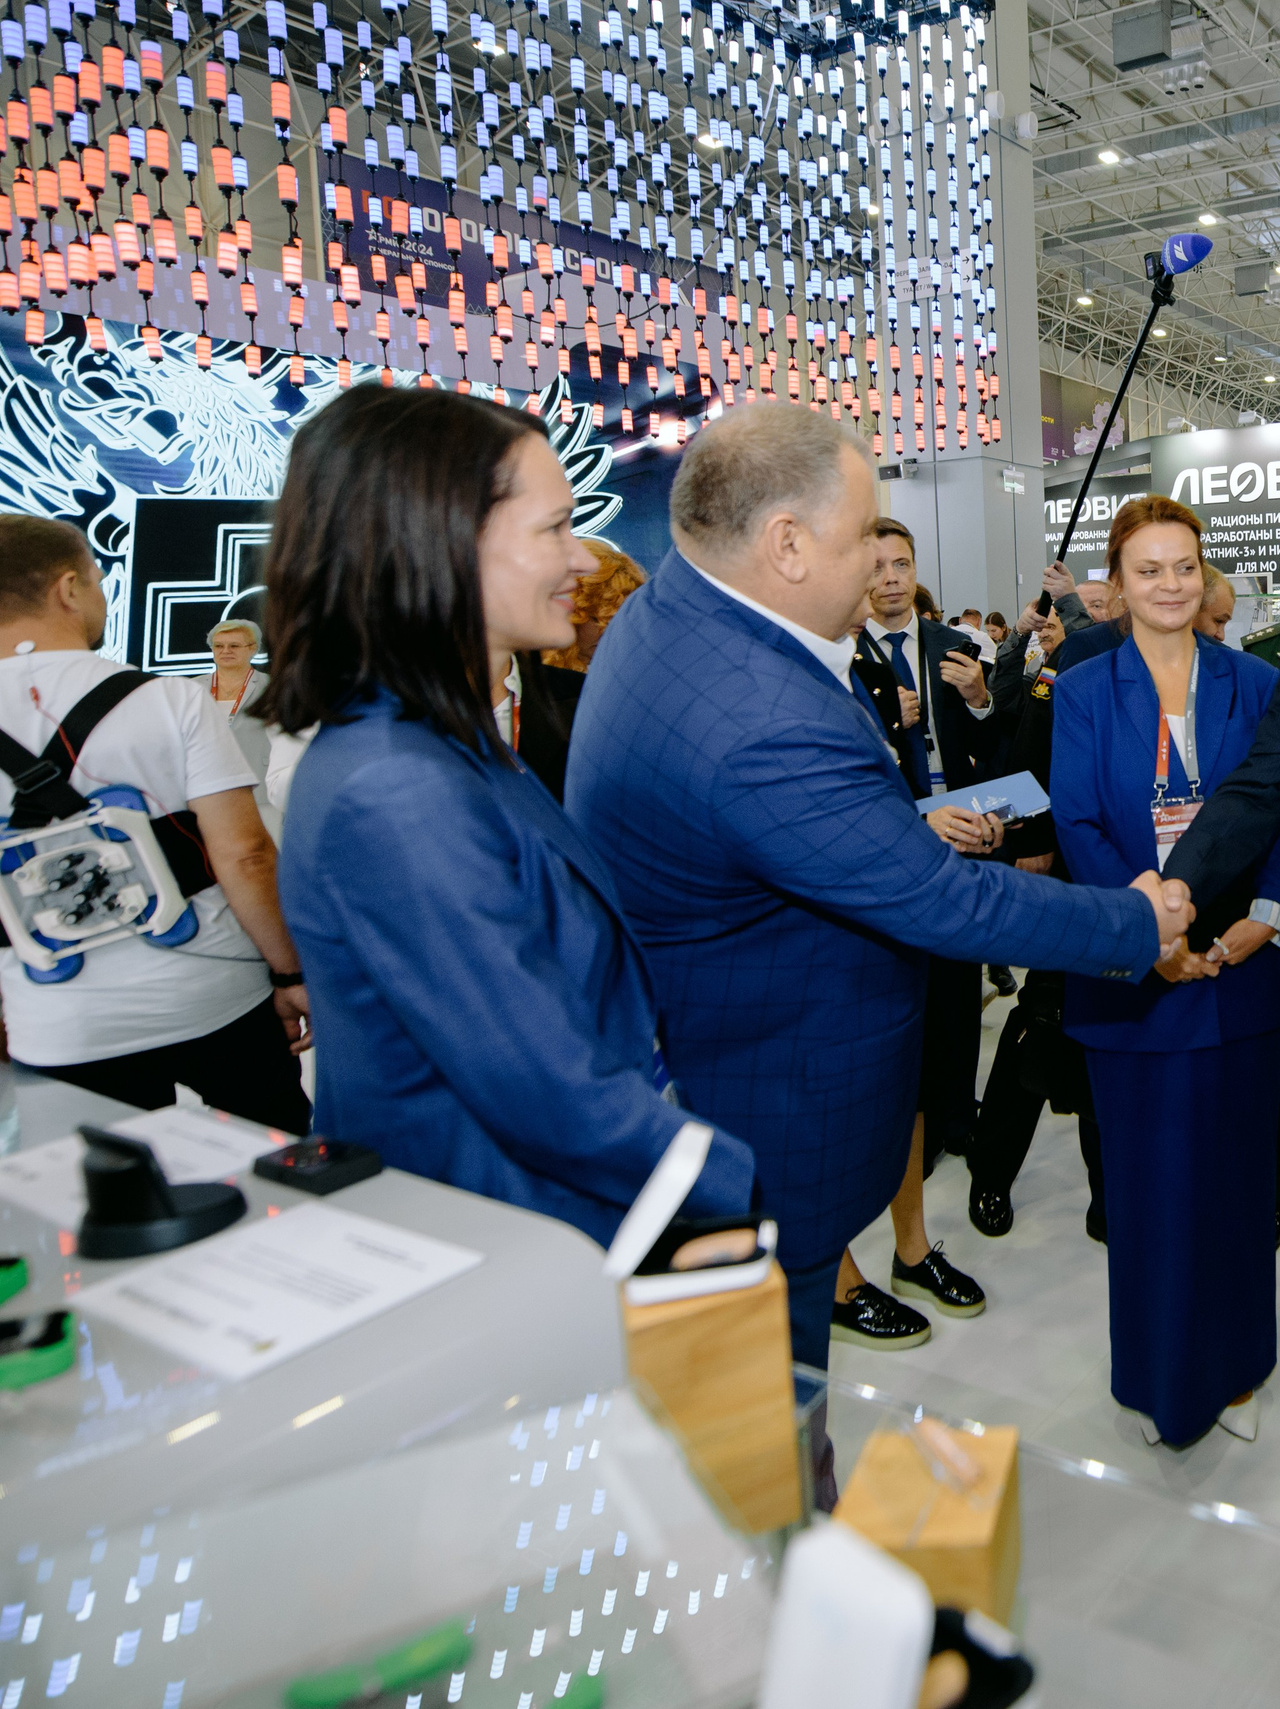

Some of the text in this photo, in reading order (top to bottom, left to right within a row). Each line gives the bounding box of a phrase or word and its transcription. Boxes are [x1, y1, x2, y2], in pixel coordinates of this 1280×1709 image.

[1210, 513, 1263, 528] РАЦИОНЫ
[1200, 529, 1273, 543] РАЗРАБОТАНЫ
[1258, 545, 1266, 556] И
[1235, 561, 1257, 574] ДЛЯ
[1259, 560, 1277, 572] МО
